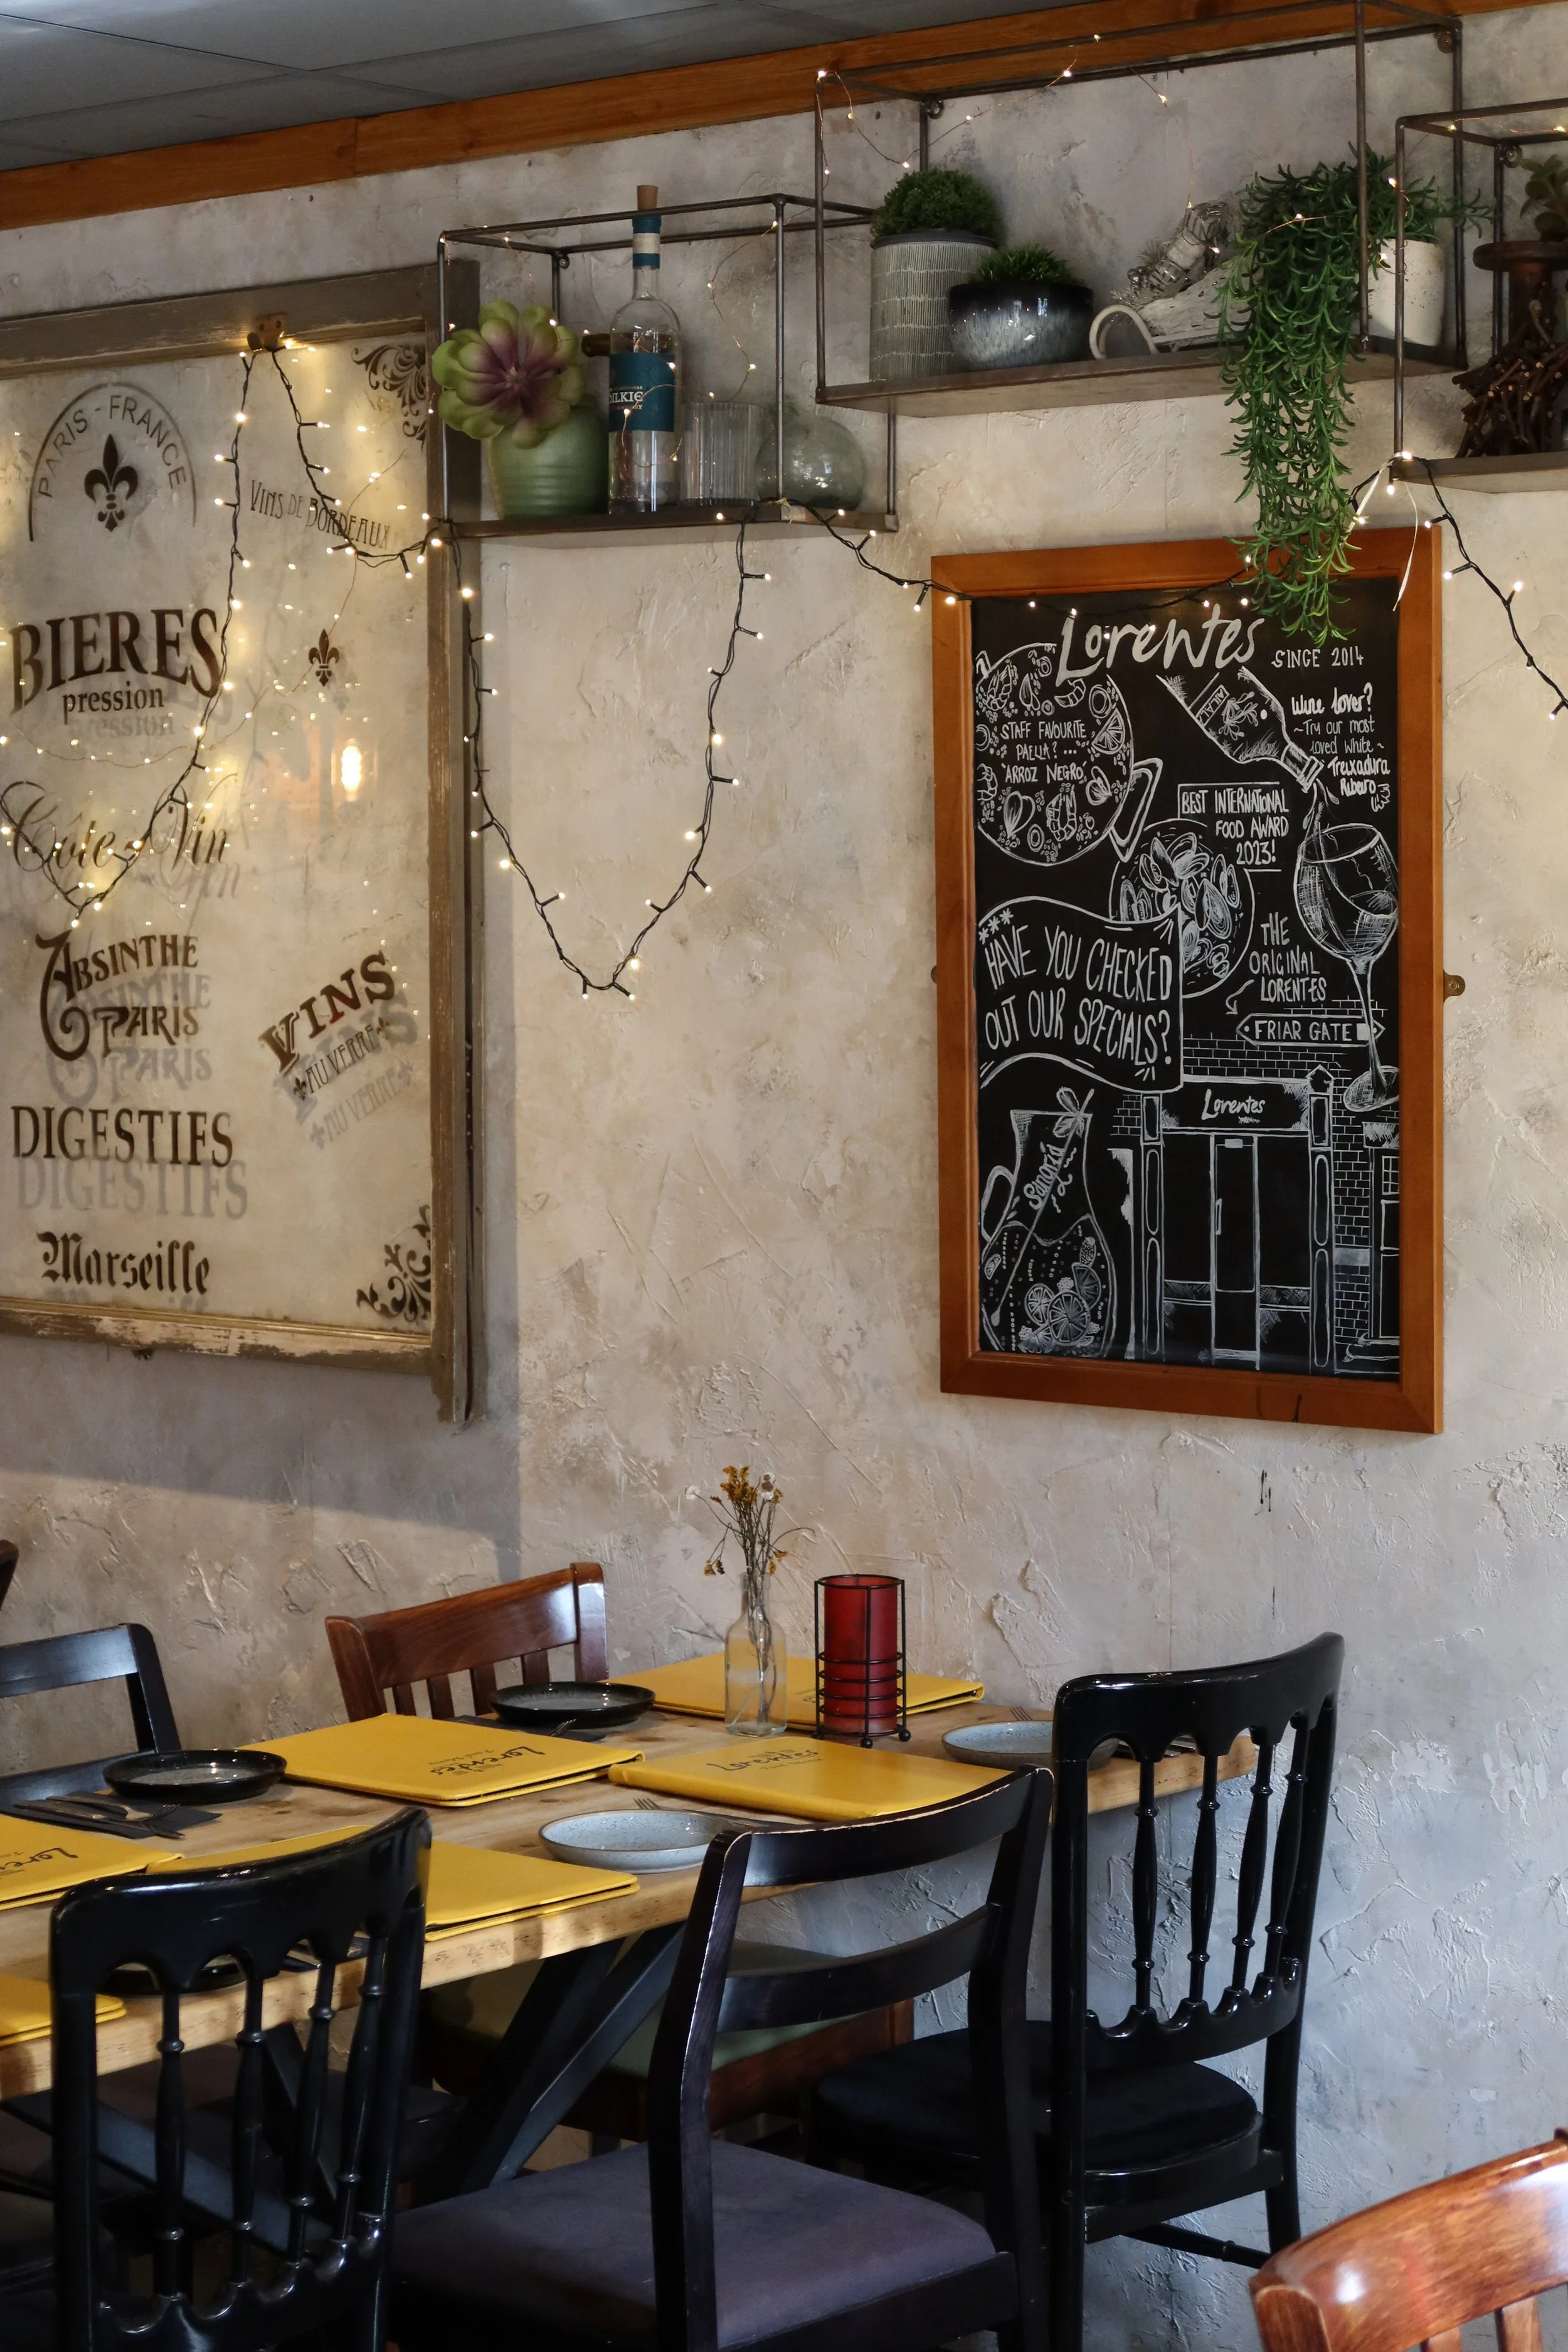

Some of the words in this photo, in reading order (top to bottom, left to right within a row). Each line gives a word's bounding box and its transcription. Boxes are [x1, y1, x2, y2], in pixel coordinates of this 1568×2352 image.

[38, 409, 88, 498] PARIS
[109, 395, 186, 489] FRANCE
[250, 480, 283, 519] VINS
[306, 497, 390, 550] BORDEAUX
[8, 608, 220, 715] BIERES
[1055, 603, 1265, 687] Lorentes
[1271, 649, 1321, 668] SINCE
[1331, 645, 1364, 666] 2014
[61, 681, 164, 725] pression
[1291, 694, 1325, 715] Wine
[1331, 682, 1373, 714] lover?
[1000, 721, 1032, 739] STAFF
[1038, 719, 1087, 739] FAVOURITE
[1326, 721, 1343, 734] our
[1349, 714, 1375, 734] most
[1310, 735, 1338, 754] loved
[1344, 736, 1374, 754] white
[1182, 790, 1209, 814] BEST
[1214, 787, 1290, 814] INTERNATIONAL
[1216, 820, 1244, 839] FOOD
[1251, 814, 1289, 839] AWARD
[1236, 839, 1276, 865] 2023!
[1260, 911, 1290, 946] THE
[985, 924, 1037, 990] HAVE
[1044, 924, 1081, 980] YOU
[1086, 938, 1172, 1003] CHECKED
[1249, 945, 1320, 976] ORIGINAL
[35, 930, 199, 1061] ABSINTHE
[1260, 976, 1327, 1003] LORENTES
[258, 950, 395, 1078] VINS
[985, 995, 1019, 1050] OUT
[1028, 987, 1066, 1040] OUR
[1074, 997, 1172, 1066] SPECIALS?
[1254, 1020, 1301, 1041] FRIAR
[1309, 1021, 1352, 1041] GATE
[326, 1024, 378, 1075] VERRE
[1201, 1088, 1266, 1120] Lorentes
[11, 1106, 233, 1167] DIGESTIFS
[36, 1231, 209, 1295] Marseille
